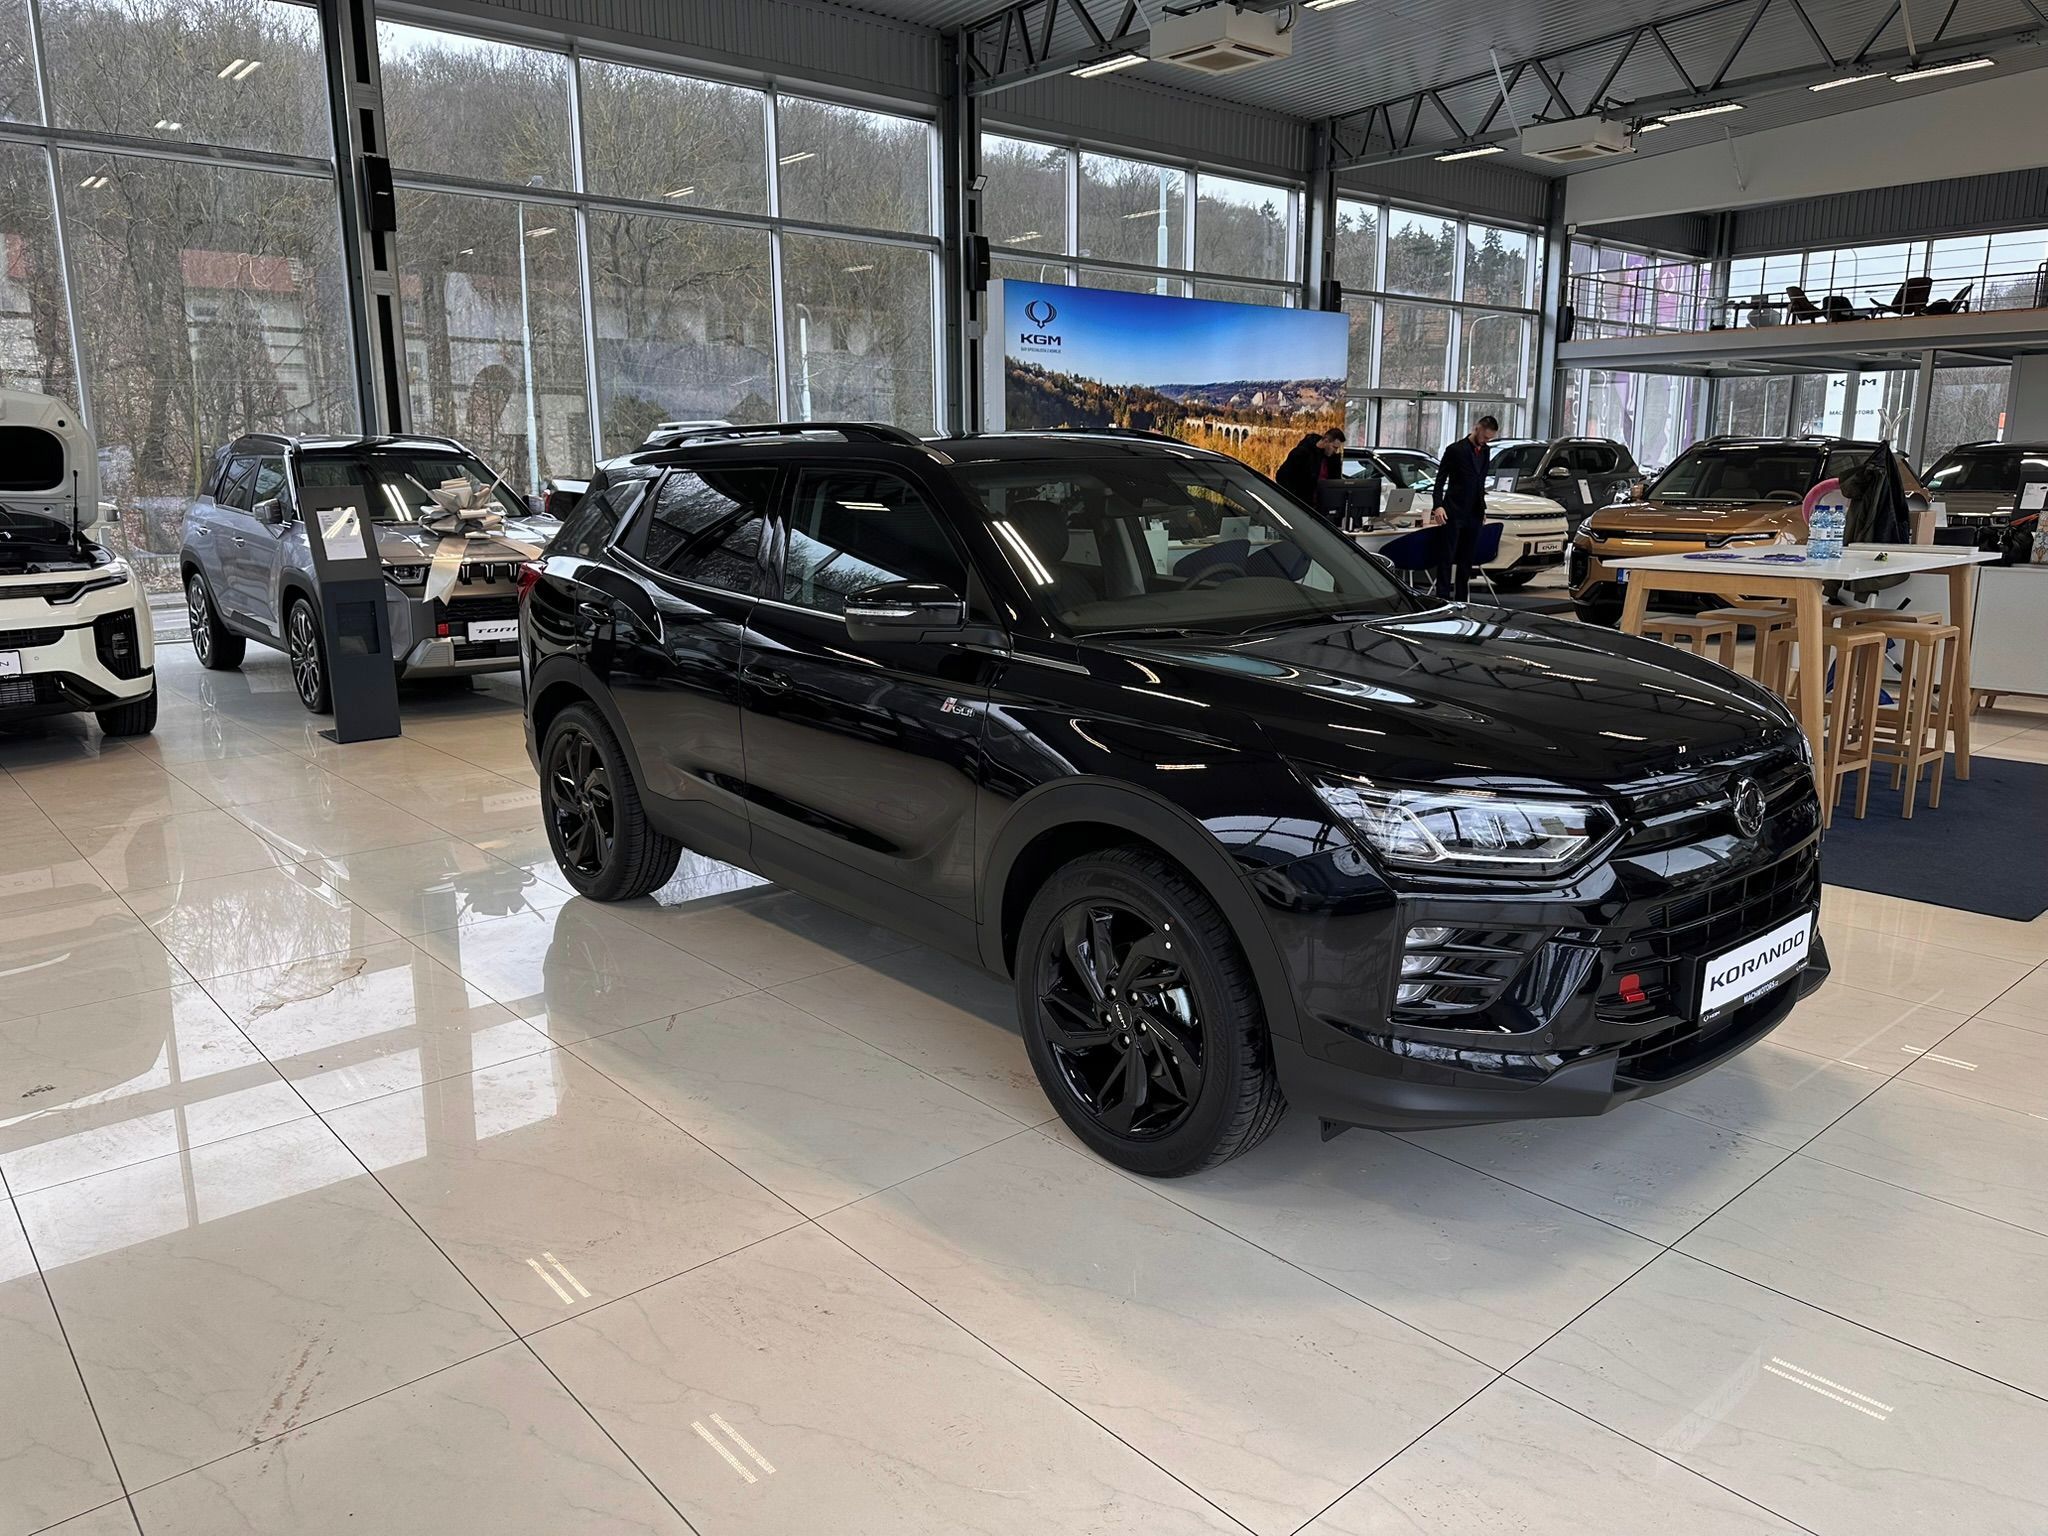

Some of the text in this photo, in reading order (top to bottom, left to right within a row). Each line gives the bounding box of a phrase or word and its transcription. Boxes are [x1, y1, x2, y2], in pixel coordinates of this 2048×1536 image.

[1020, 333, 1061, 346] KGM
[1833, 378, 1877, 387] KM
[1710, 930, 1804, 992] KORANDO
